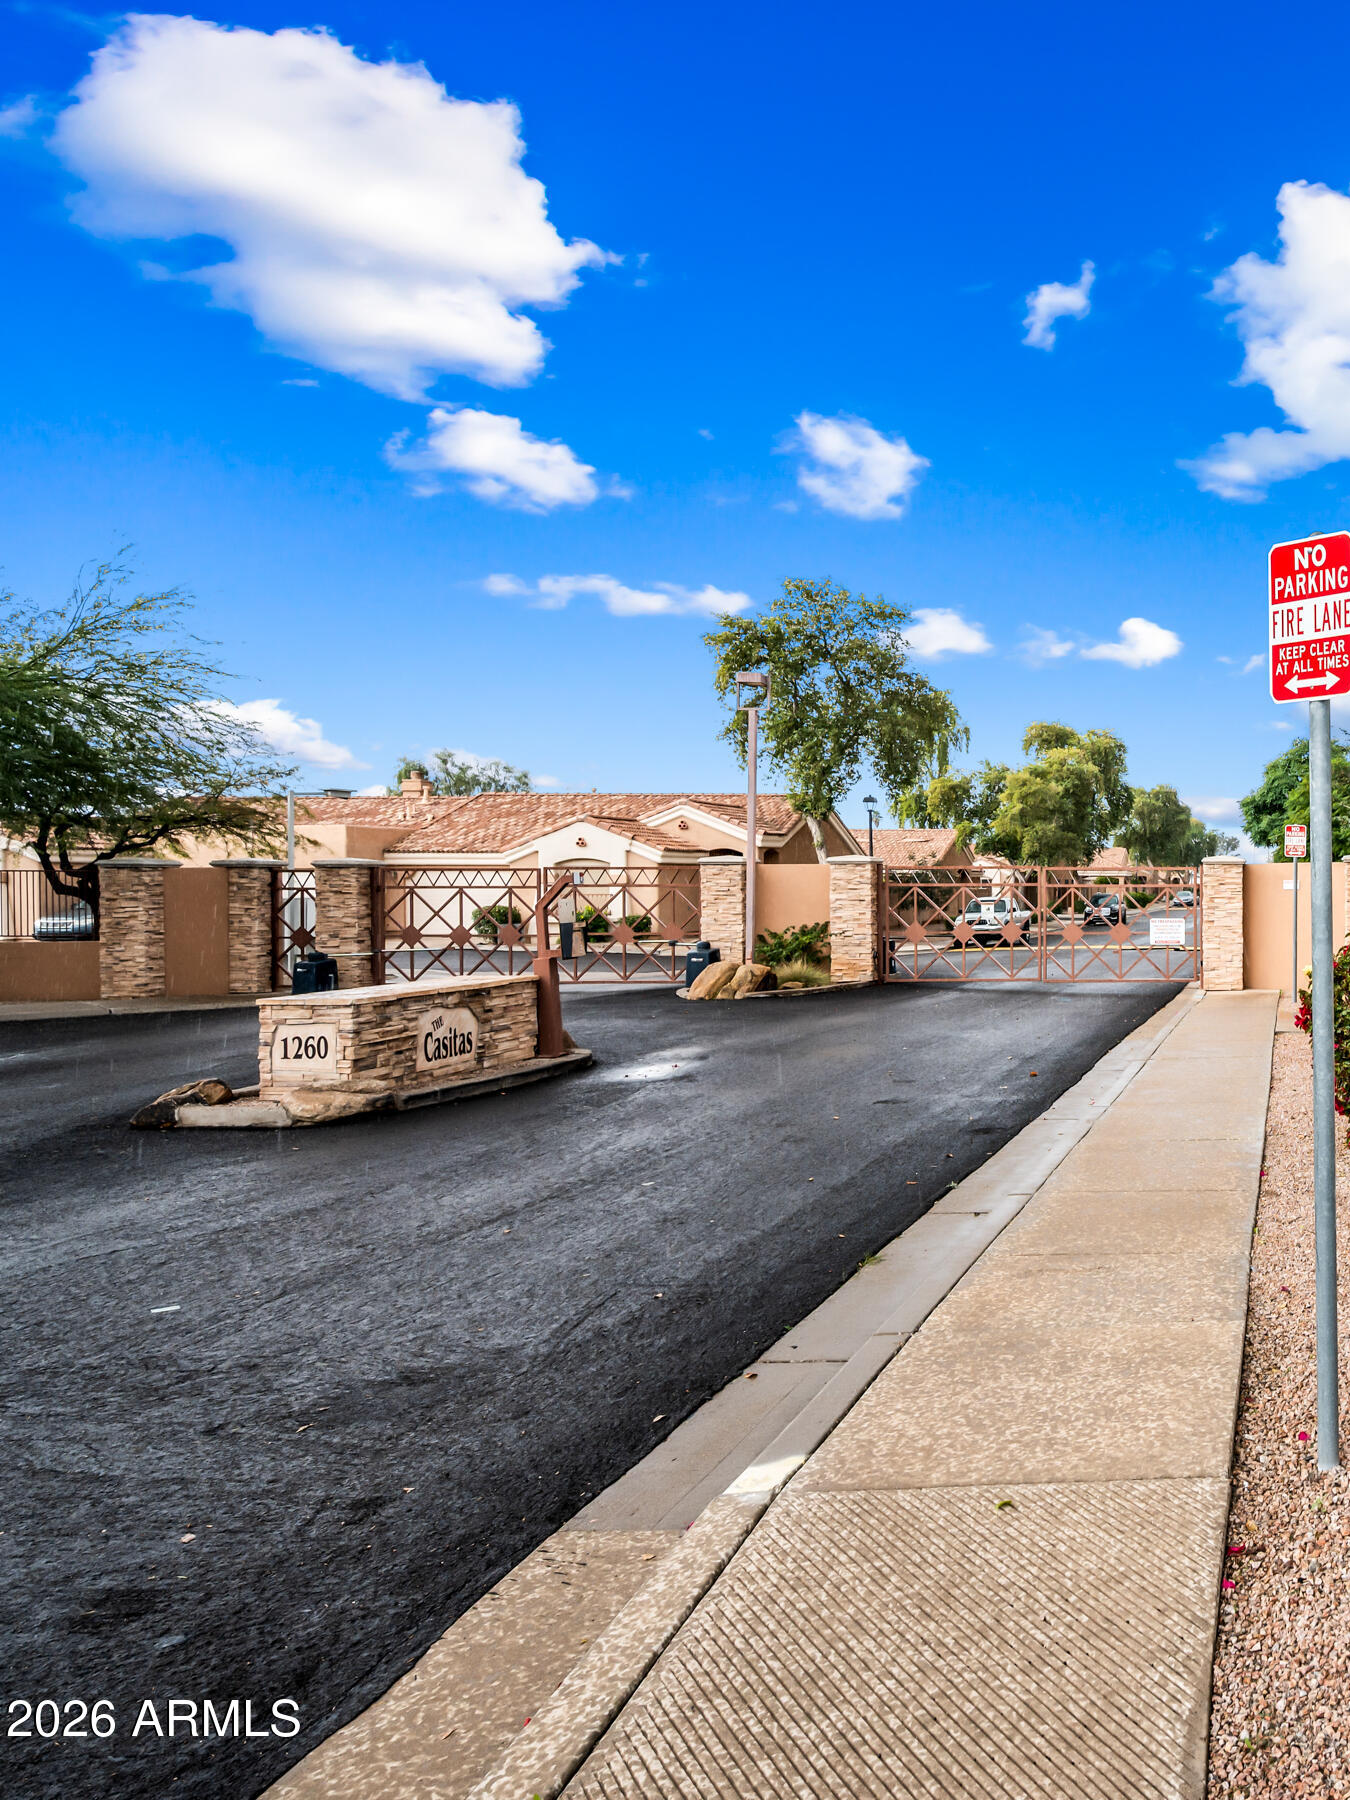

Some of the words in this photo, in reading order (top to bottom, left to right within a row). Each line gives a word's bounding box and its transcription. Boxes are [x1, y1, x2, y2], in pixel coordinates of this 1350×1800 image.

[1294, 544, 1326, 571] NO
[1274, 566, 1348, 600] PARKING
[1272, 606, 1304, 639] FIRE
[1314, 599, 1350, 633] LANE
[1279, 645, 1306, 661] KEEP
[1310, 639, 1345, 655] CLEAR
[1275, 662, 1289, 676] AT
[1293, 659, 1313, 673] ALL
[1318, 654, 1349, 670] TIMES
[431, 1015, 444, 1032] THE
[280, 1035, 329, 1059] 1260
[424, 1027, 473, 1062] Casitas
